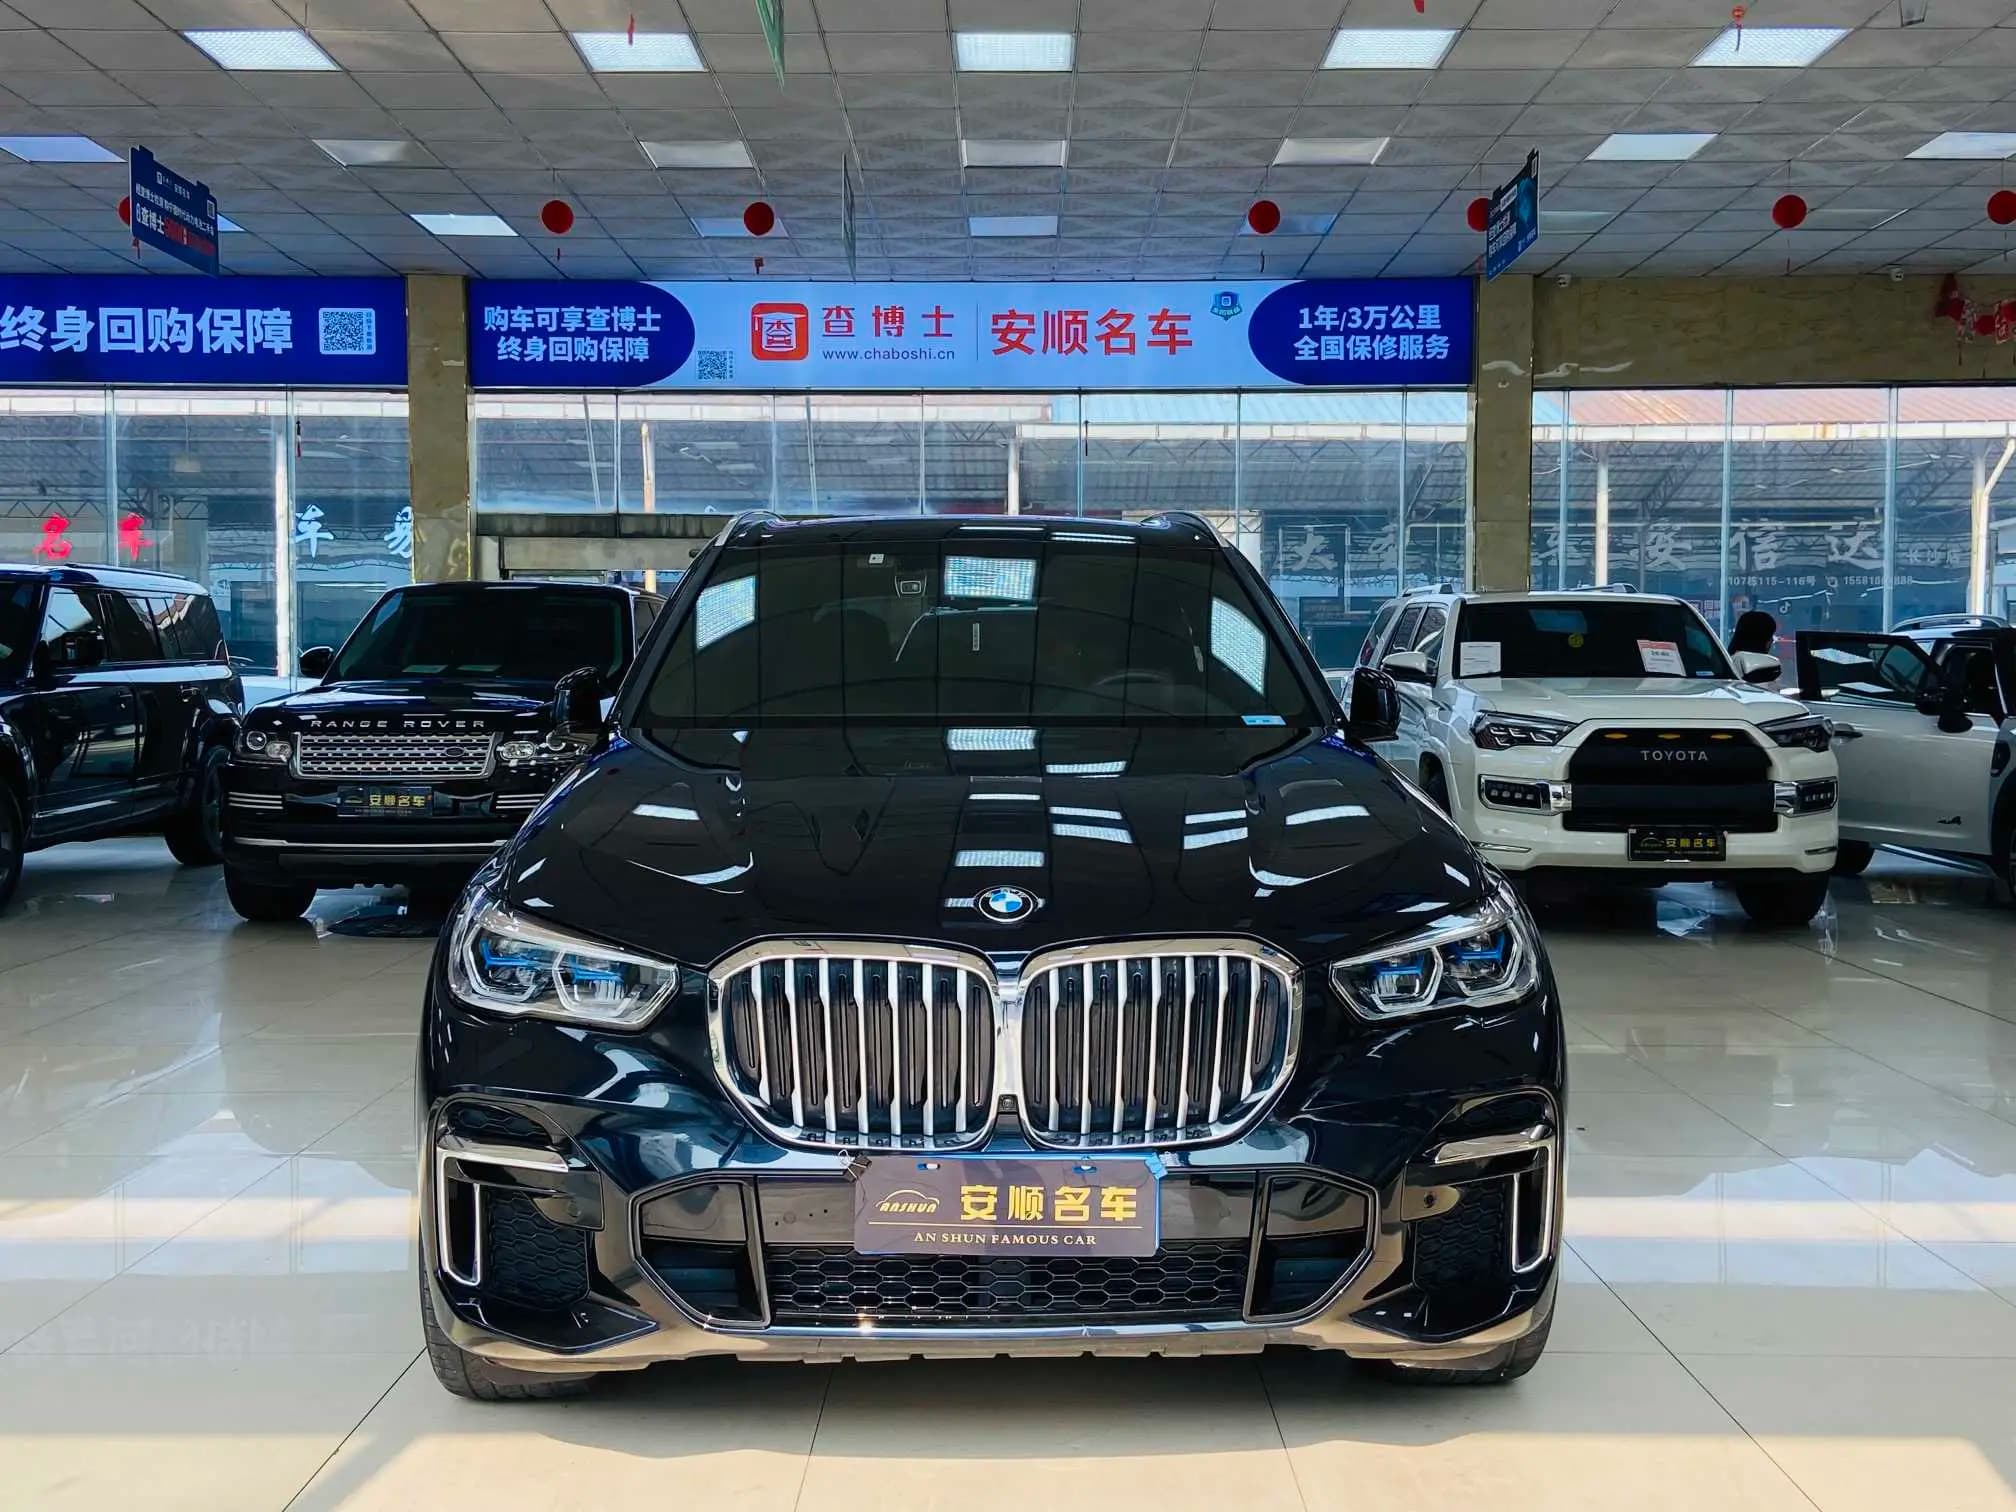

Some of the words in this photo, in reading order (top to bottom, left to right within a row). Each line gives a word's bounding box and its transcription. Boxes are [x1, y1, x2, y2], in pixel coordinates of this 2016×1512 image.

[0, 305, 293, 354] 终身回购保障
[484, 306, 661, 332] 购车可享查博士
[822, 305, 954, 337] 查博士
[1299, 304, 1441, 331] 1年/3万公里
[991, 308, 1192, 356] 安顺名车
[497, 336, 650, 363] 终身回购保障
[822, 347, 955, 360] www.chaboshi.cn
[1294, 334, 1450, 361] 全国保修服务
[310, 720, 388, 728] RANGE
[403, 720, 485, 728] ROVER
[1641, 750, 1708, 761] TOYOTA
[960, 1184, 1137, 1222] 安顺名车
[914, 1232, 937, 1243] AN
[942, 1232, 987, 1244] SHUN
[992, 1233, 1057, 1245] FAMOUS
[1062, 1234, 1097, 1245] CAR
